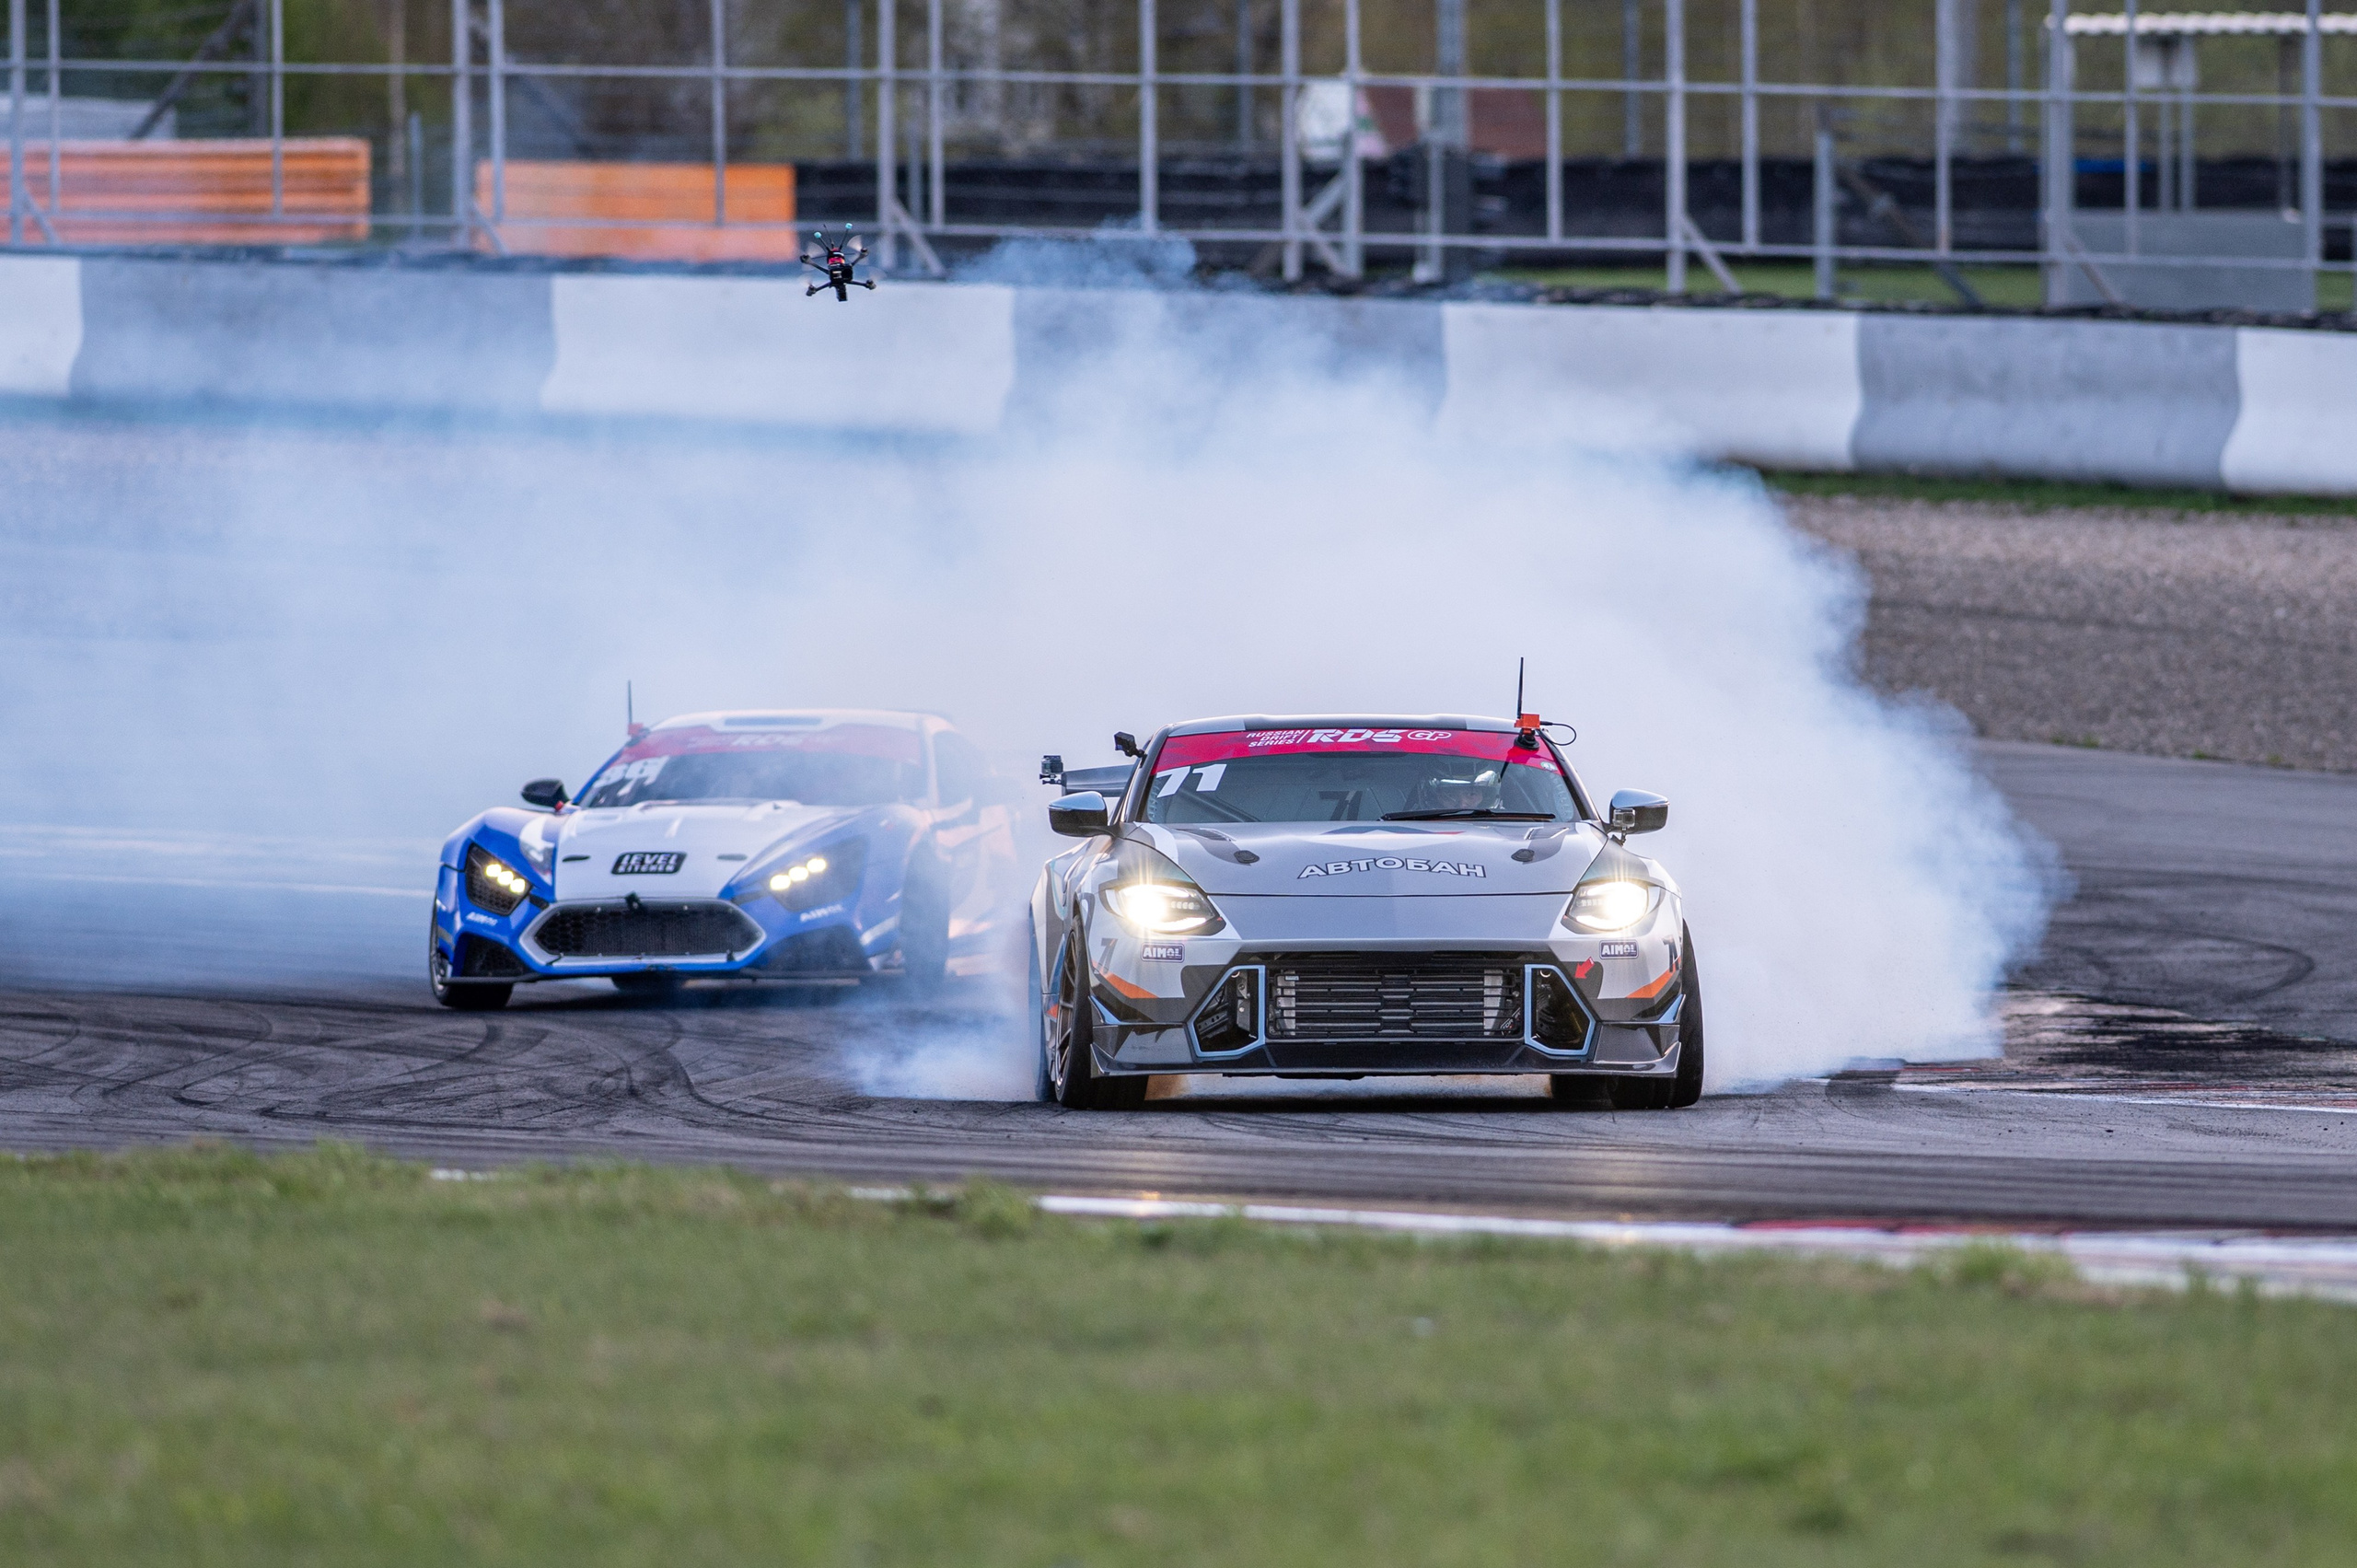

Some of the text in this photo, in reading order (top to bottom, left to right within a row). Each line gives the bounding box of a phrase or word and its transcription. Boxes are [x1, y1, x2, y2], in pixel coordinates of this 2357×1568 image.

[1246, 729, 1305, 738] RUSSIAN
[1260, 734, 1299, 742] DRIFT
[1306, 728, 1452, 743] RDS GP
[1248, 738, 1295, 748] SERIES
[1155, 763, 1227, 798] 71
[1318, 790, 1364, 821] 71
[621, 854, 679, 865] LEVEL
[1297, 856, 1487, 878] АВТОБАН
[1143, 947, 1182, 958] AIMOL
[1602, 944, 1637, 955] AIMOL
